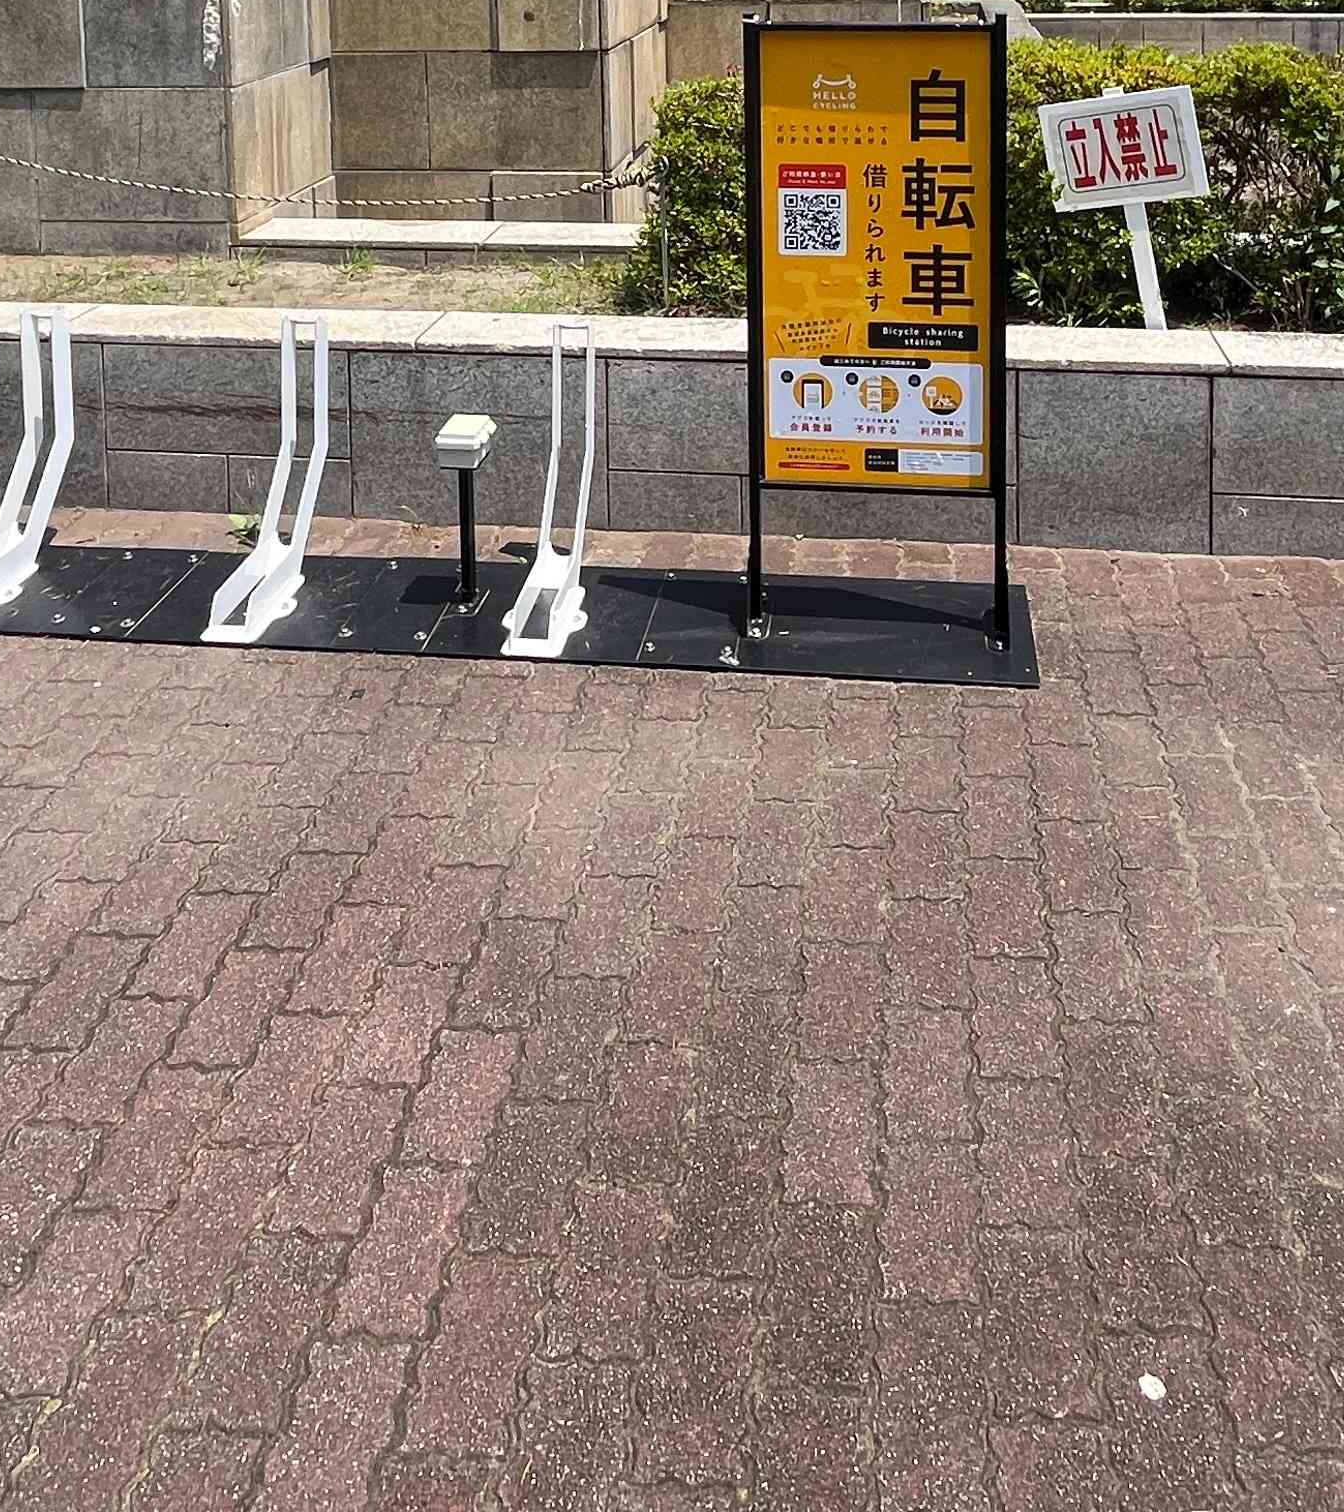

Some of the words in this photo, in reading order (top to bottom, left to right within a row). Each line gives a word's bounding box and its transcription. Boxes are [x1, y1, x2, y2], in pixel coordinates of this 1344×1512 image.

[812, 91, 857, 100] HELLO
[812, 102, 857, 110] CYCLING
[1065, 108, 1178, 188] 立入禁止
[901, 68, 976, 316] 自転車
[862, 163, 888, 312] 借りられます
[882, 326, 919, 337] Bicycle
[925, 327, 964, 339] sharing
[904, 338, 942, 346] station
[790, 422, 832, 432] 会員登録
[855, 424, 897, 435] 予約する
[920, 427, 964, 438] 利用開始
